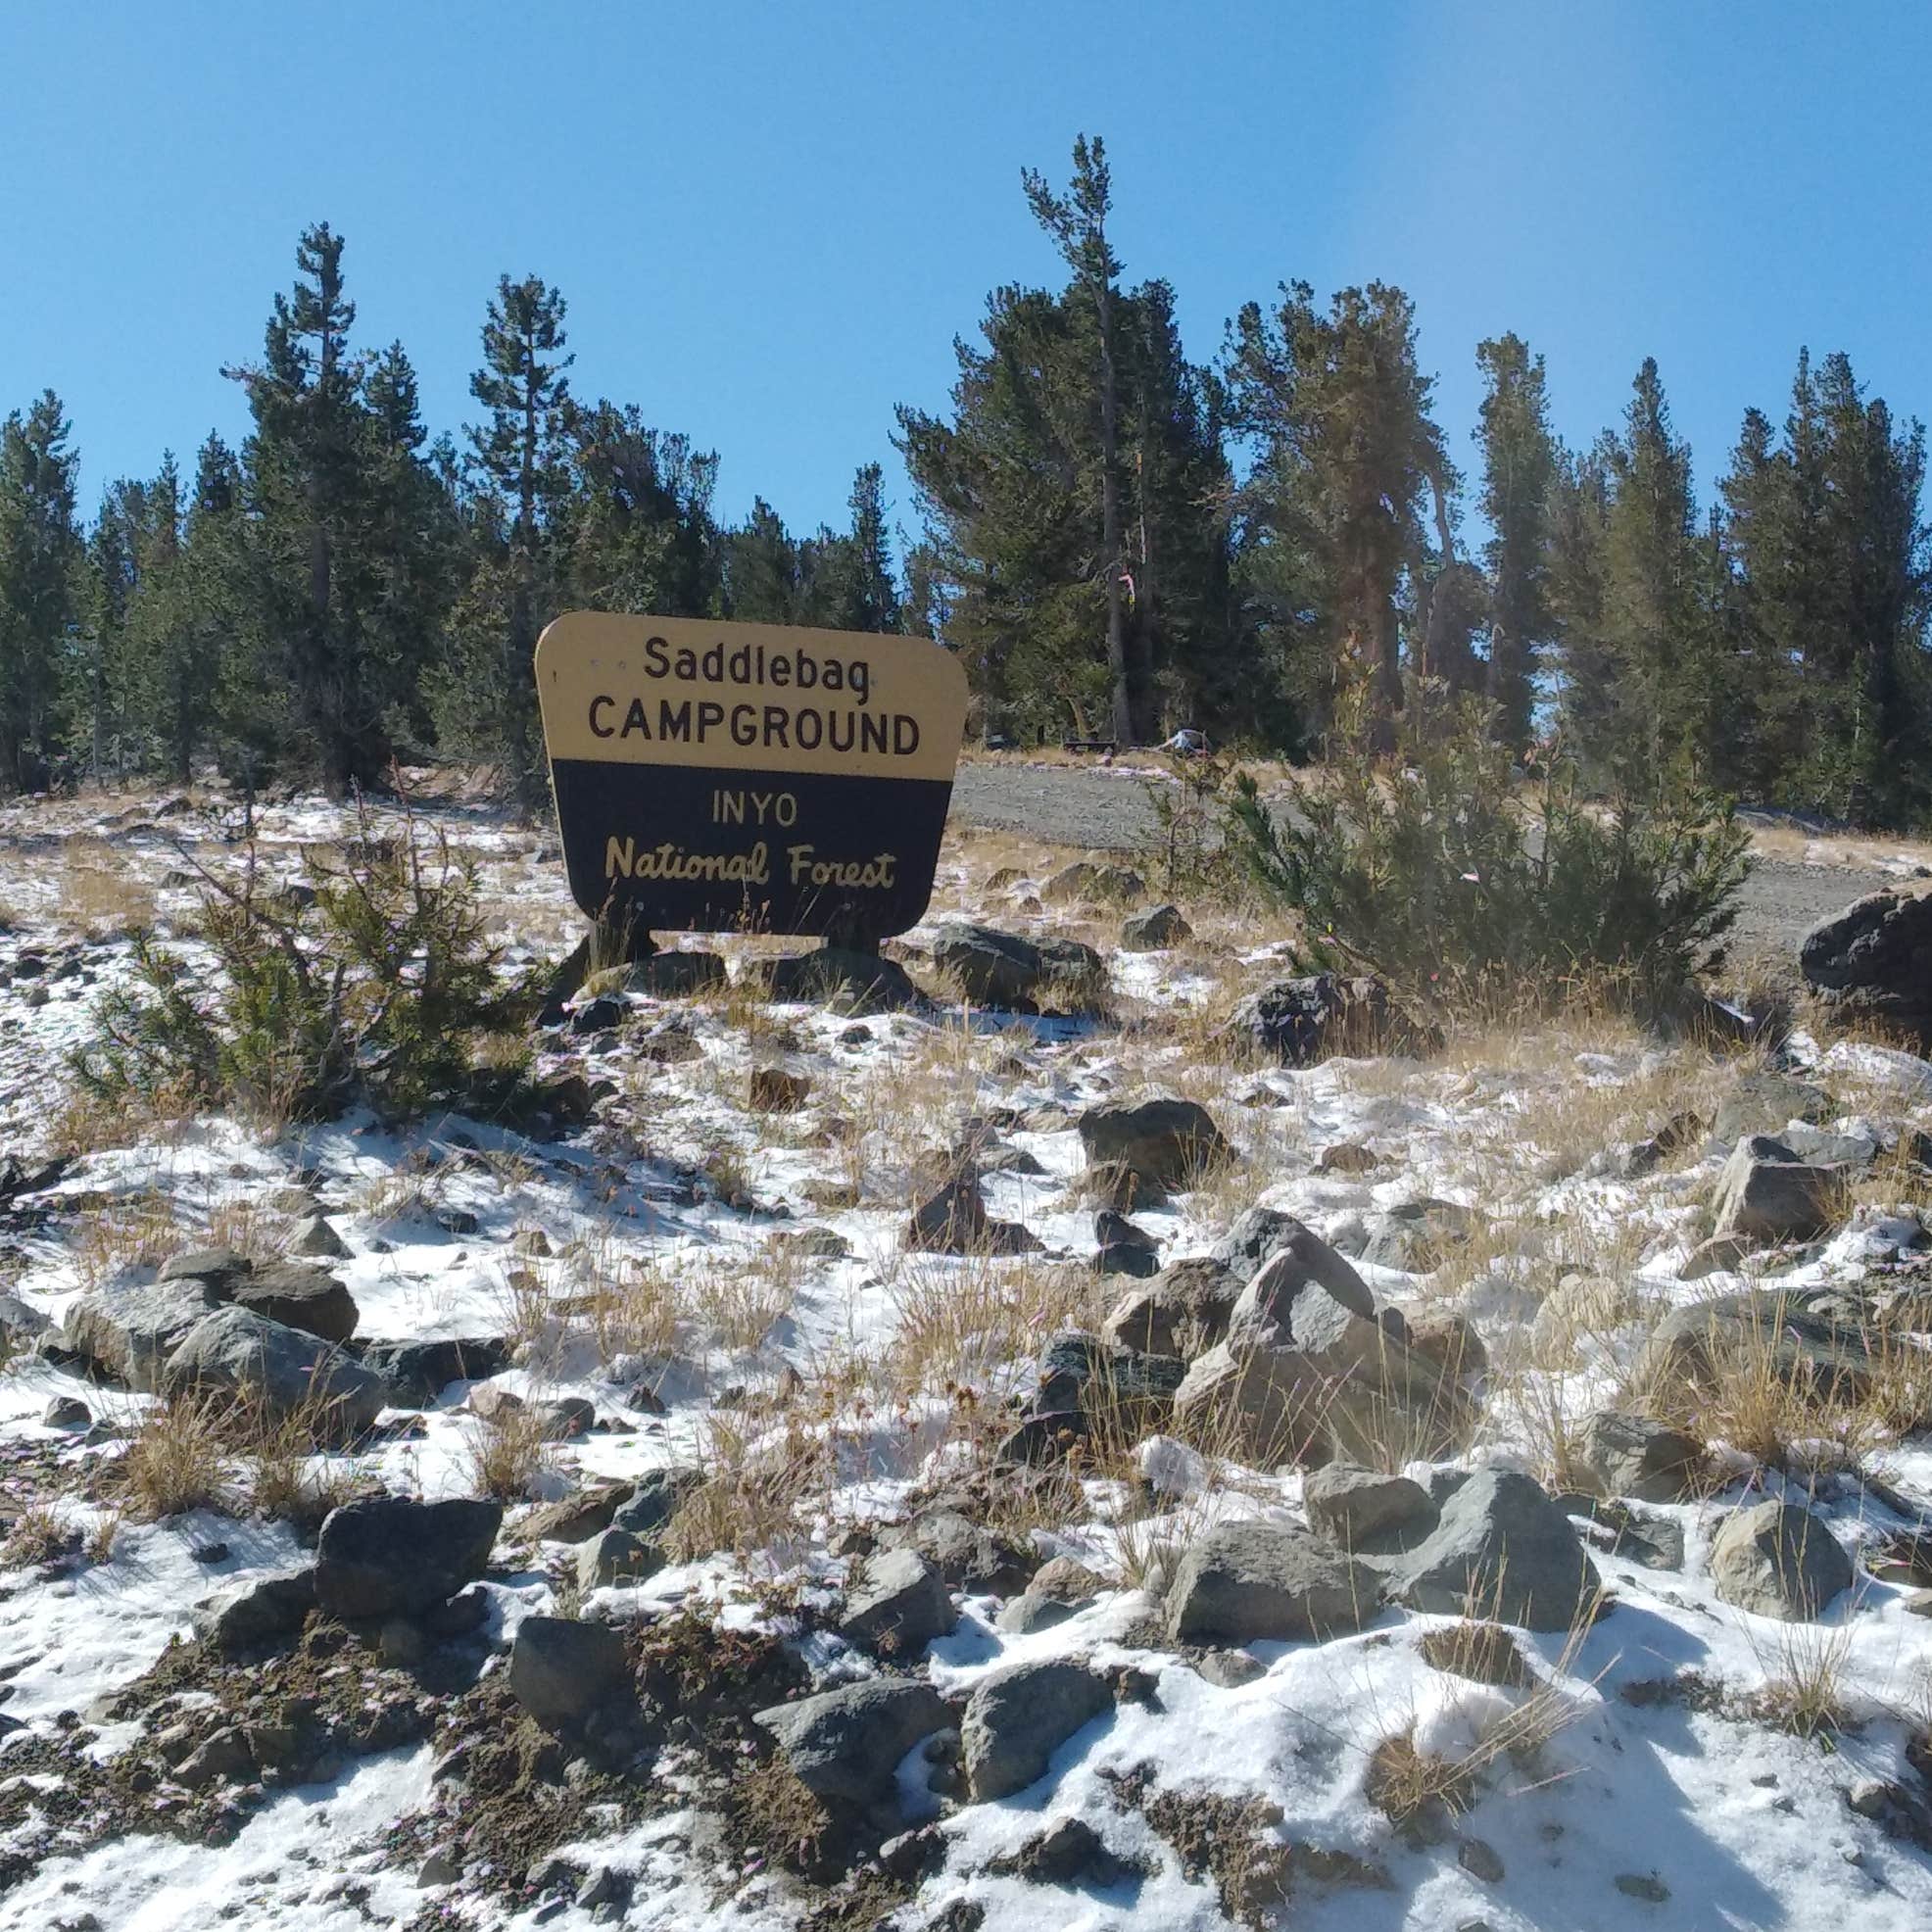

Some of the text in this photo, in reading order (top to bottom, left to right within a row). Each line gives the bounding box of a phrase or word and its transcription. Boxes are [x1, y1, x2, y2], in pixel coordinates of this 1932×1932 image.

[644, 636, 870, 706] Saddlebag
[588, 695, 921, 756] CAMPGROUND
[712, 789, 798, 828] INYO
[604, 835, 898, 889] National Forest
